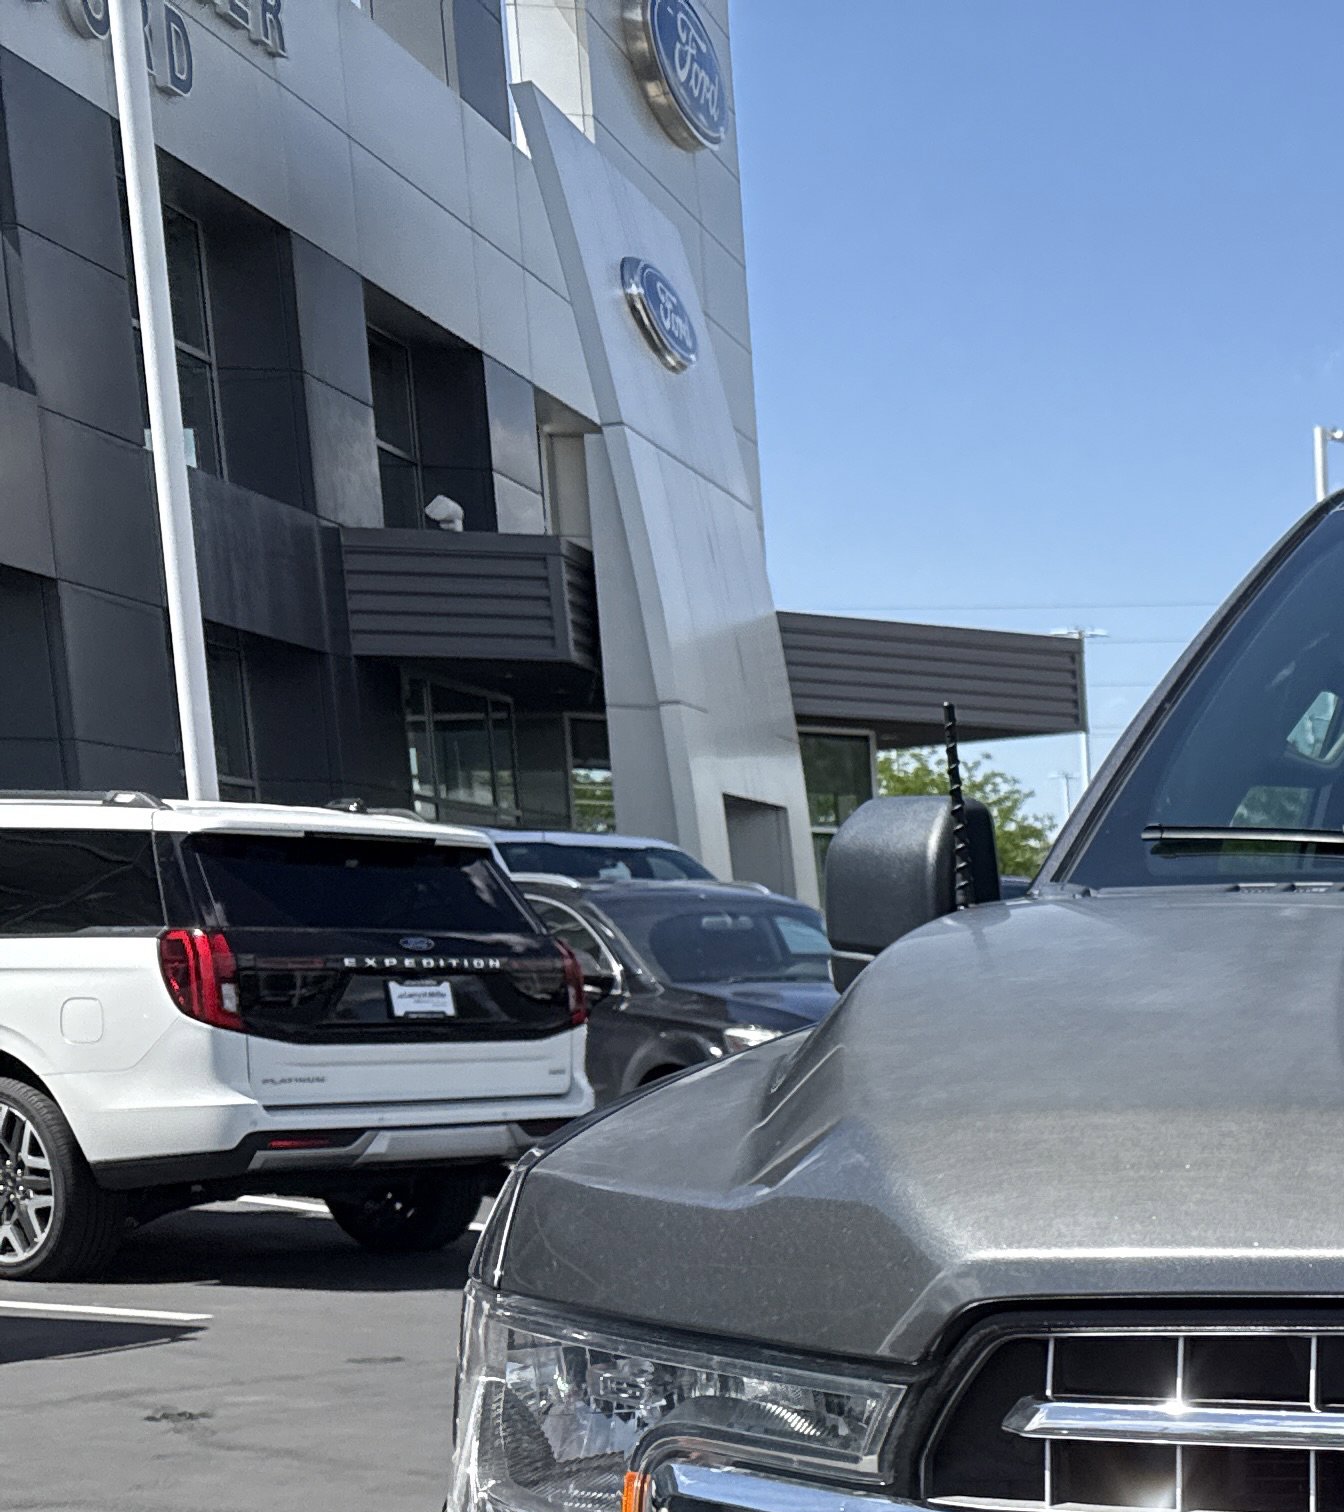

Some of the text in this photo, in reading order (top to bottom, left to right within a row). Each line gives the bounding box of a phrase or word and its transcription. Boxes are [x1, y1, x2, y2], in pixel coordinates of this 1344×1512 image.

[674, 11, 719, 121] Ford
[656, 281, 693, 350] Ford
[343, 957, 501, 969] EXPEDITION
